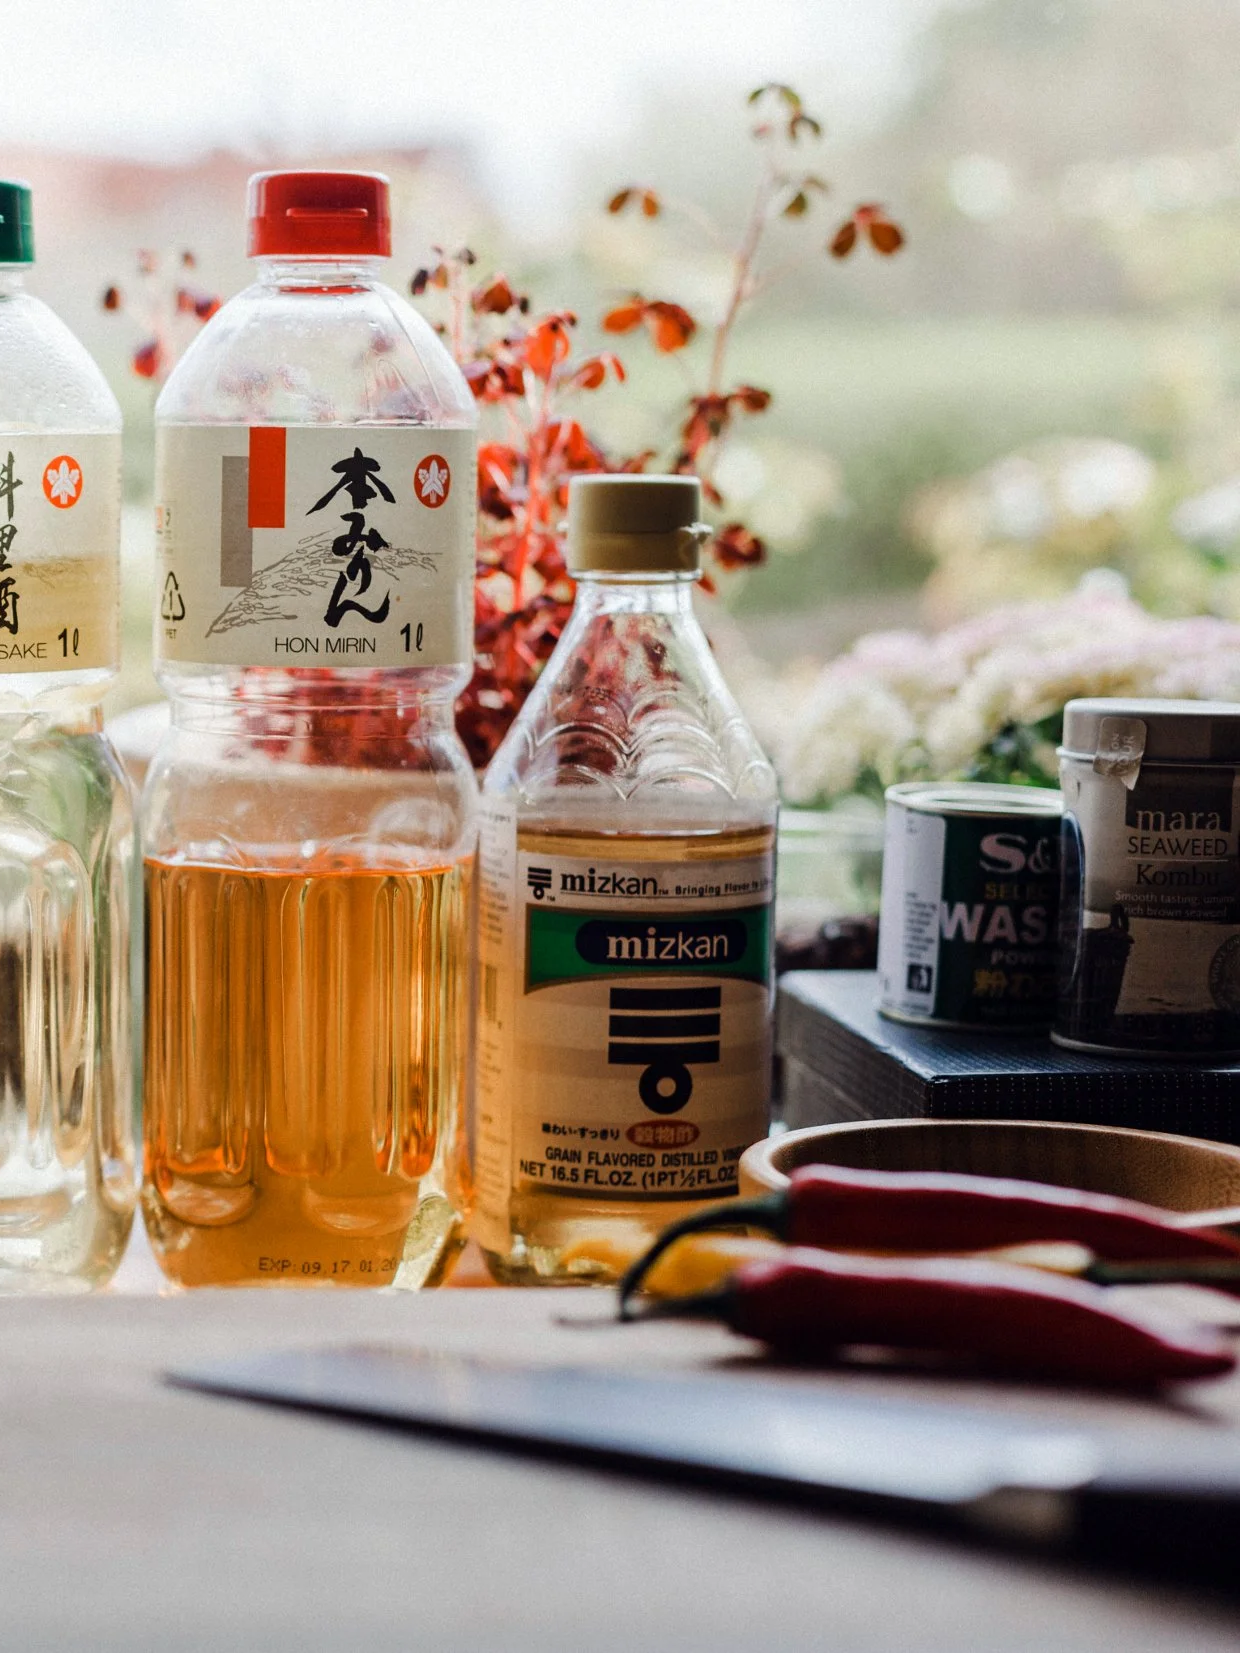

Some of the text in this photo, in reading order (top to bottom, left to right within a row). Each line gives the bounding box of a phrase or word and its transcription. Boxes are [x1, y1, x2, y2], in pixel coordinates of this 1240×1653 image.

[305, 446, 396, 628] 本みりん
[274, 637, 376, 653] HON MIRIN
[1136, 810, 1221, 832] mara
[1127, 836, 1228, 857] SEAWEED
[560, 867, 658, 895] mizkan
[675, 884, 721, 897] Bringing
[1135, 863, 1220, 886] Kombu
[1115, 890, 1158, 903] Smooth
[939, 902, 1049, 944] WAS
[606, 926, 728, 960] mizkan
[545, 1146, 582, 1165] GRAIN
[588, 1150, 656, 1167] FLAVORED
[661, 1149, 718, 1167] DISTILLED
[520, 1160, 545, 1178] NET
[551, 1163, 581, 1183] 16.5
[584, 1168, 637, 1187] FL.OZ.
